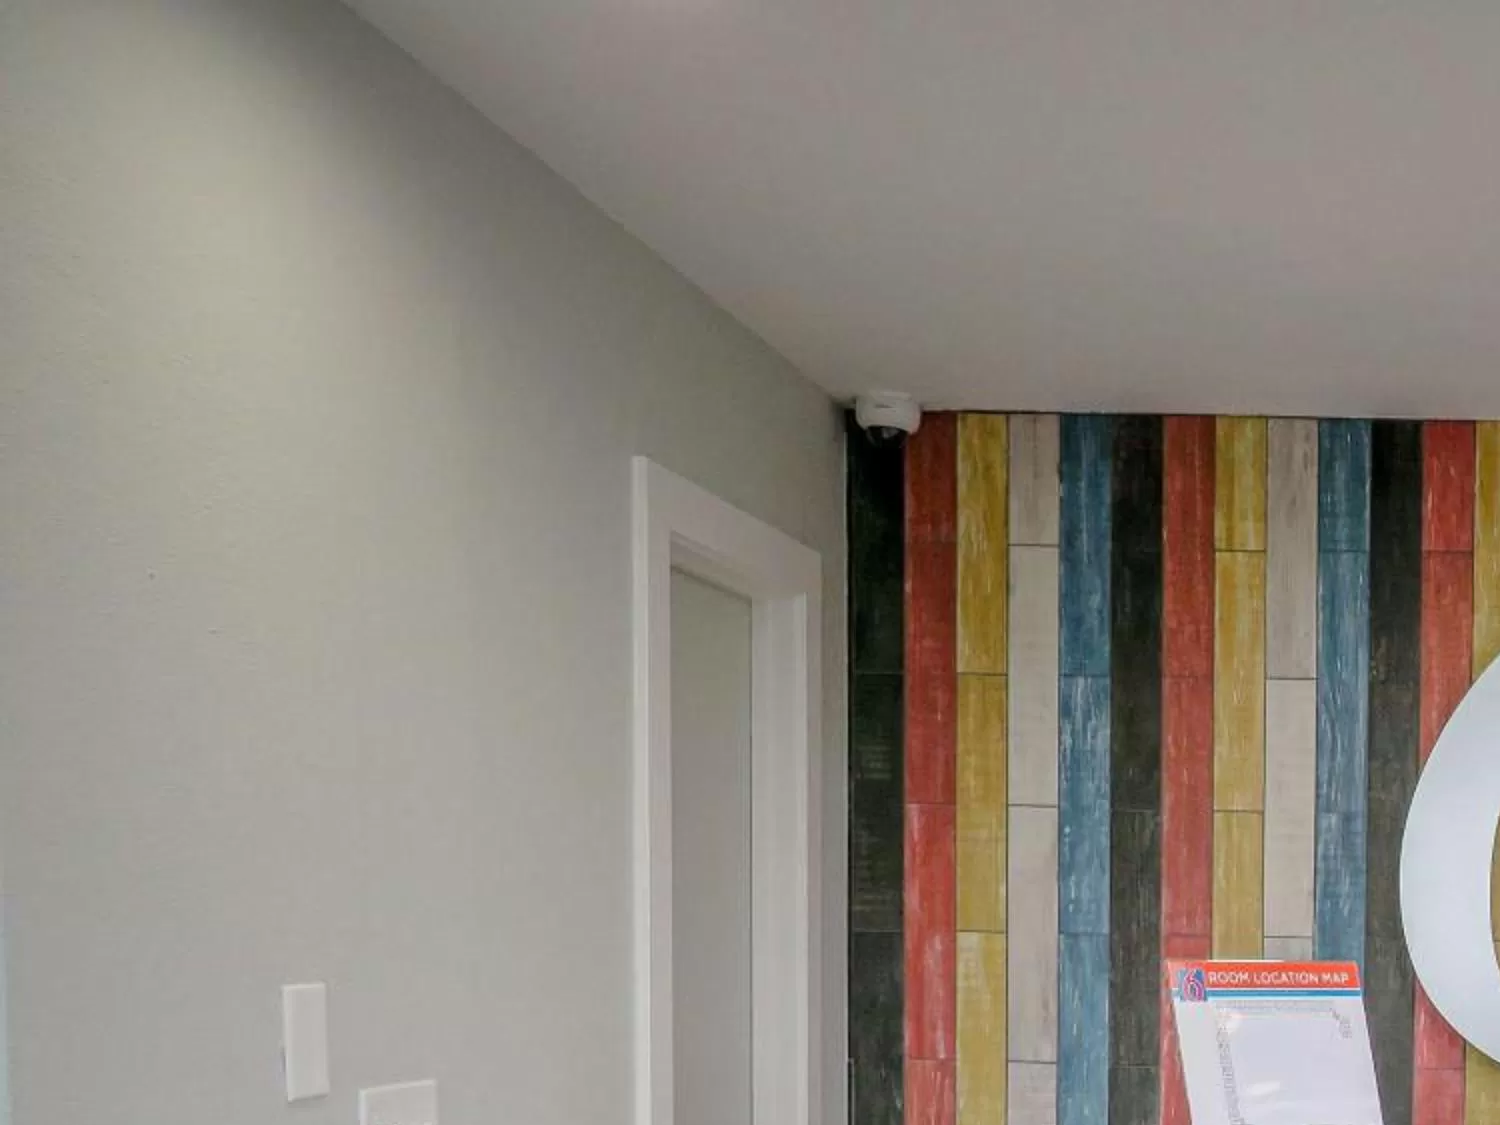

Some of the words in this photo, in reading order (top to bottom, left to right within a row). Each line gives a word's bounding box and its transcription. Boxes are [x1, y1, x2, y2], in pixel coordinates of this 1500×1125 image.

[1208, 971, 1250, 985] ROOM
[1253, 971, 1319, 985] LOCATION
[1321, 971, 1349, 985] MAP
